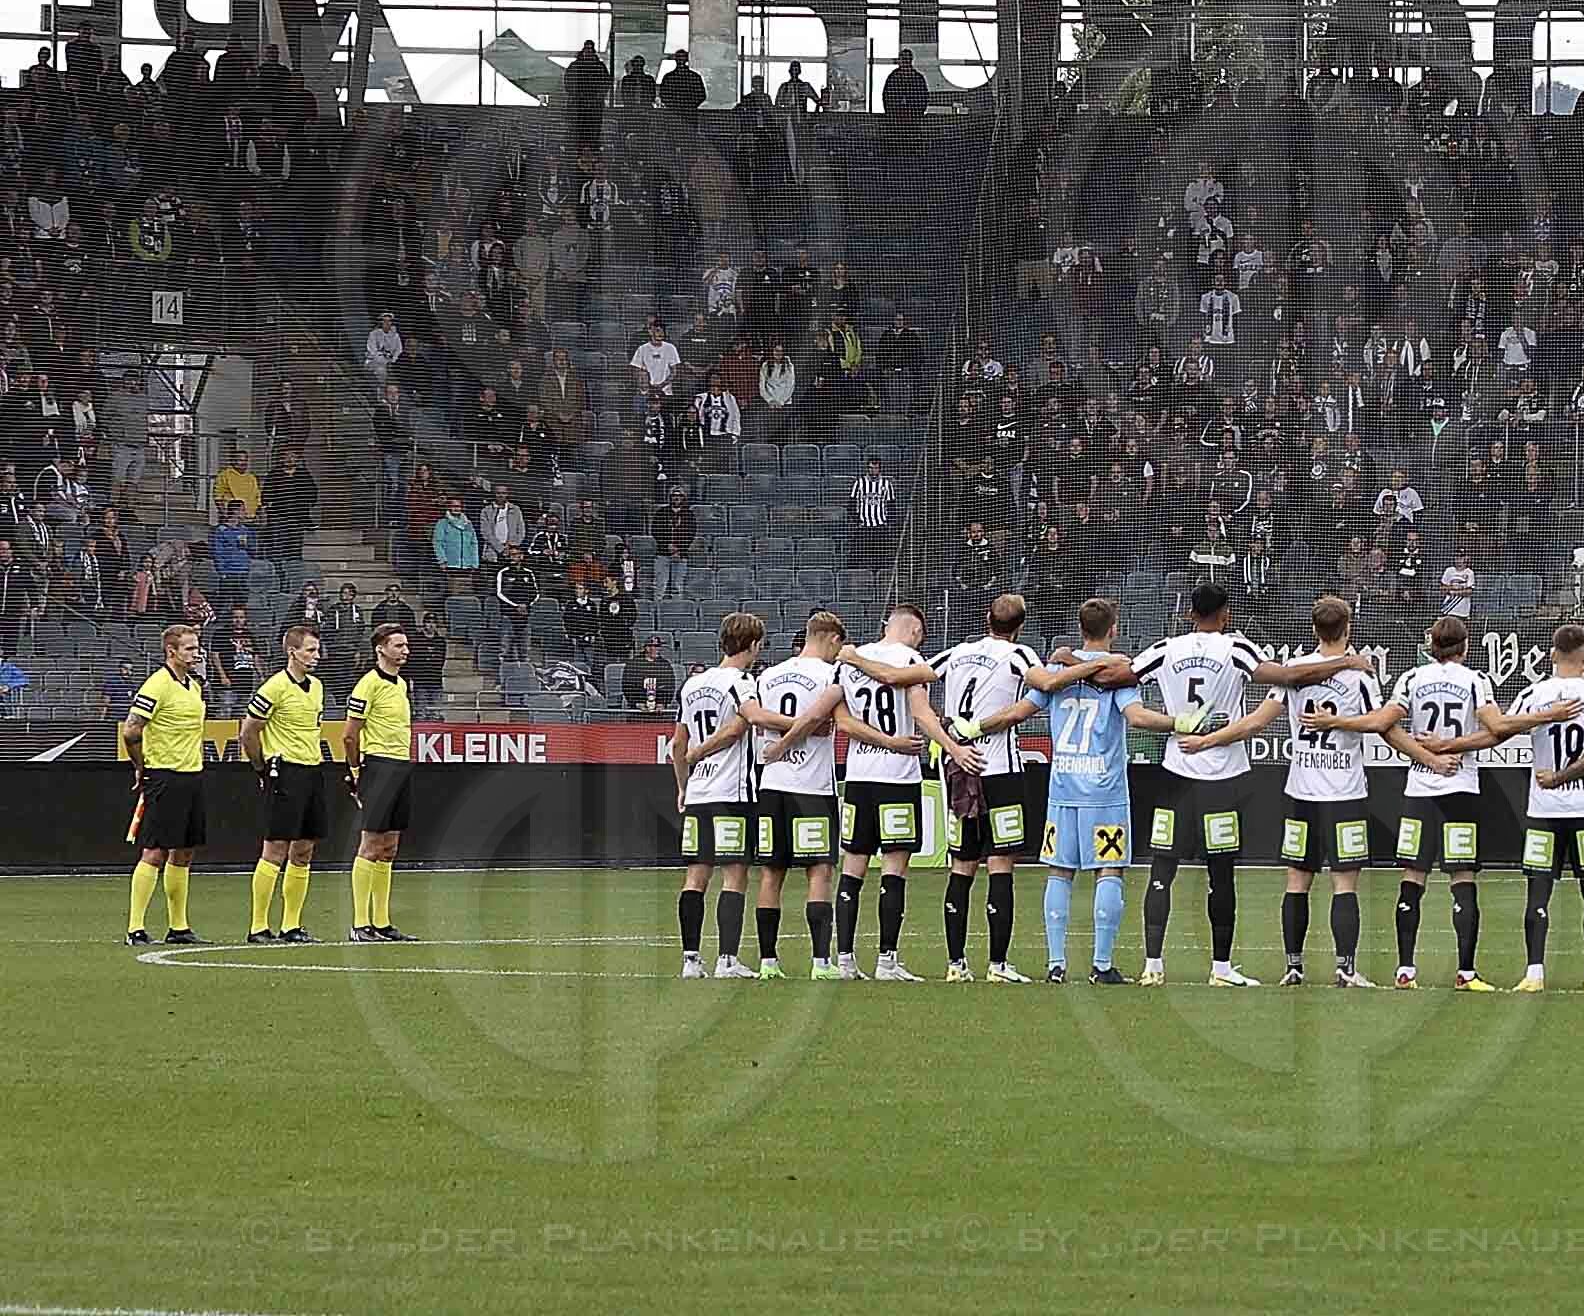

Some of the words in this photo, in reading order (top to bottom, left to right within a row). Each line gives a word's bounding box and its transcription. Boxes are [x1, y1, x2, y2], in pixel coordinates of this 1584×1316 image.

[154, 293, 181, 322] 14
[1055, 698, 1100, 753] 27
[1420, 701, 1464, 740] 25
[418, 734, 547, 763] KLEINE
